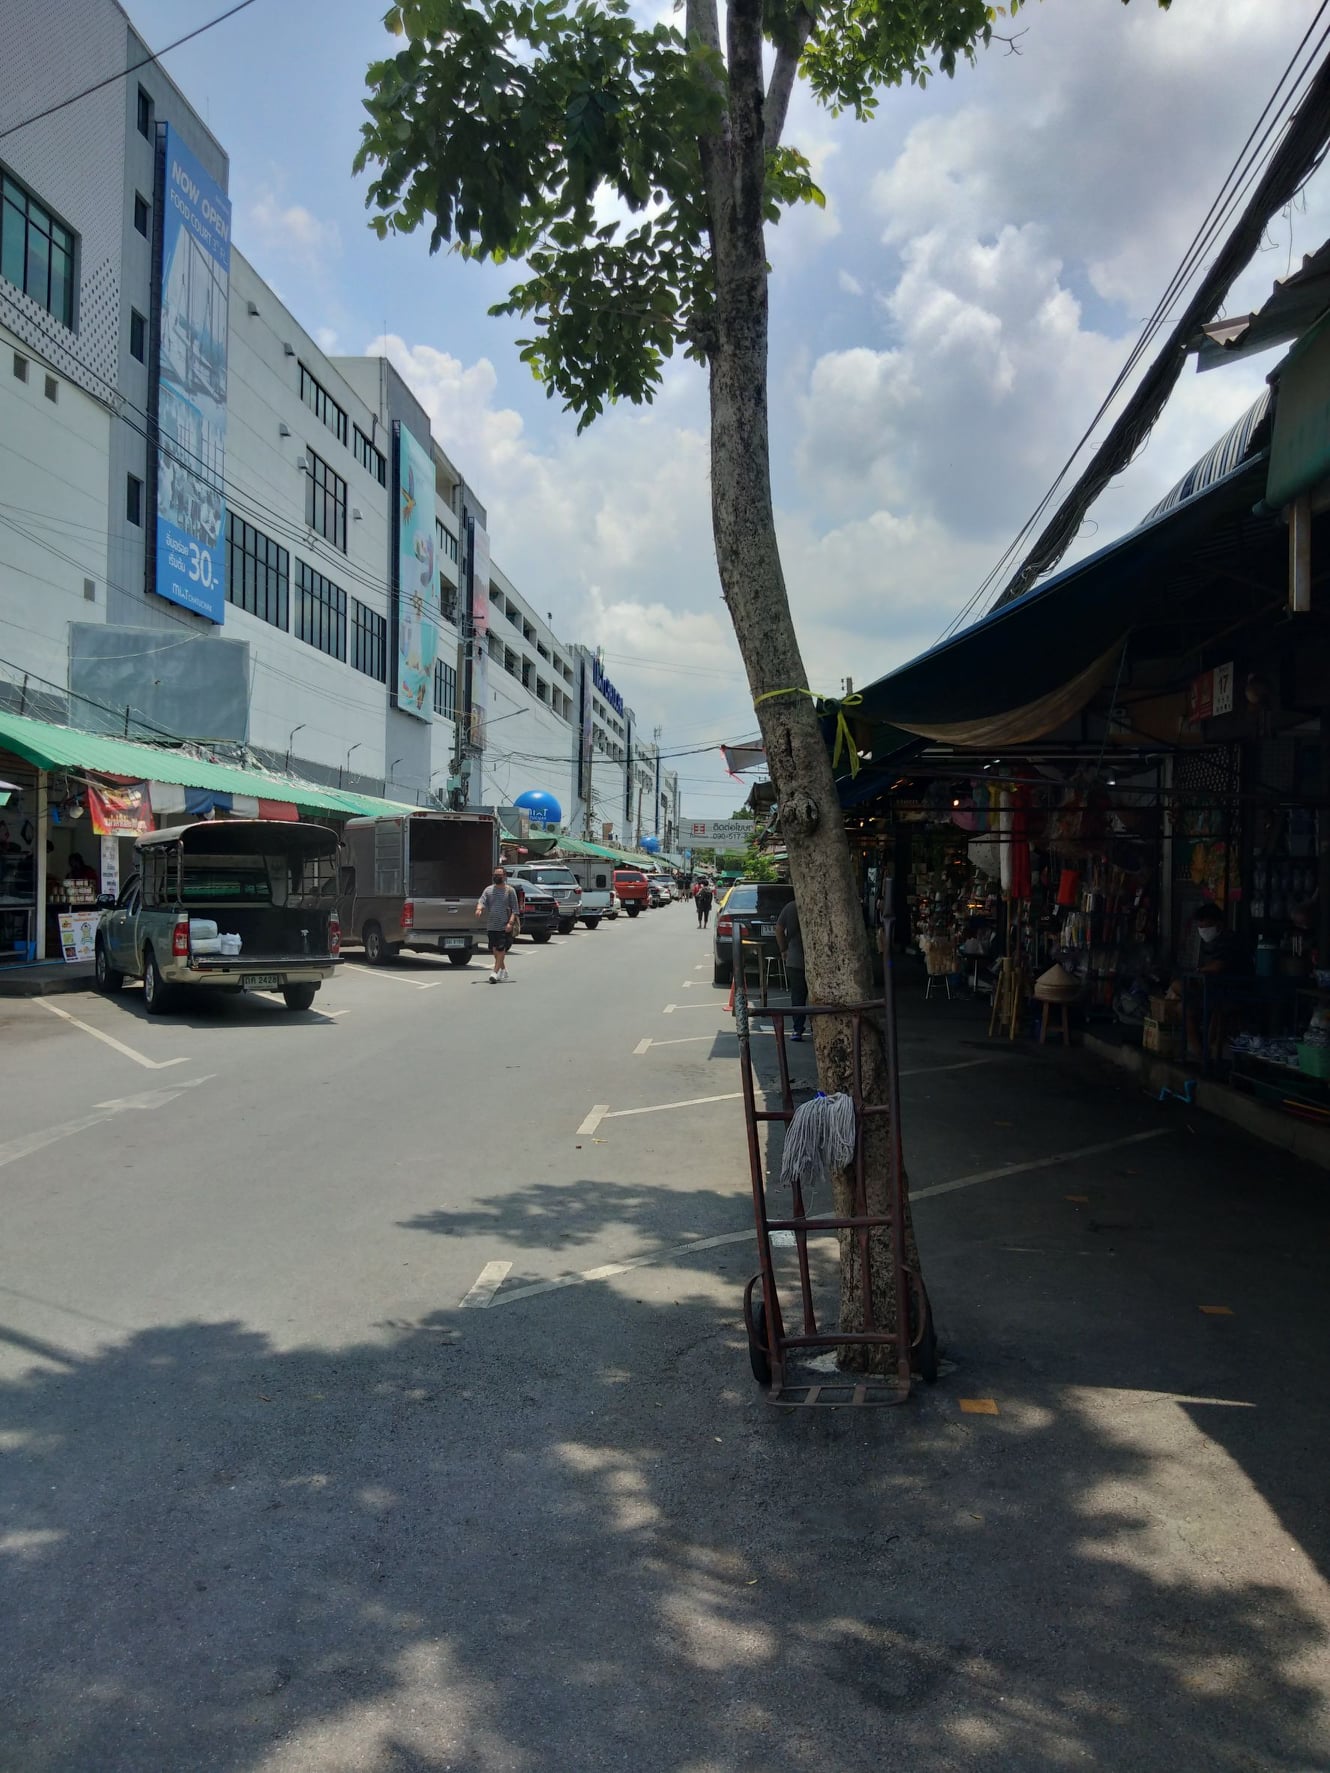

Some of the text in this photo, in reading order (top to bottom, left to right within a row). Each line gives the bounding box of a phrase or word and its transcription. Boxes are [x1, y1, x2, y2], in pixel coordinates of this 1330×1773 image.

[170, 188, 191, 220] FOOD
[191, 213, 211, 245] COURT
[172, 160, 200, 205] NOW
[201, 199, 230, 242] OPEN
